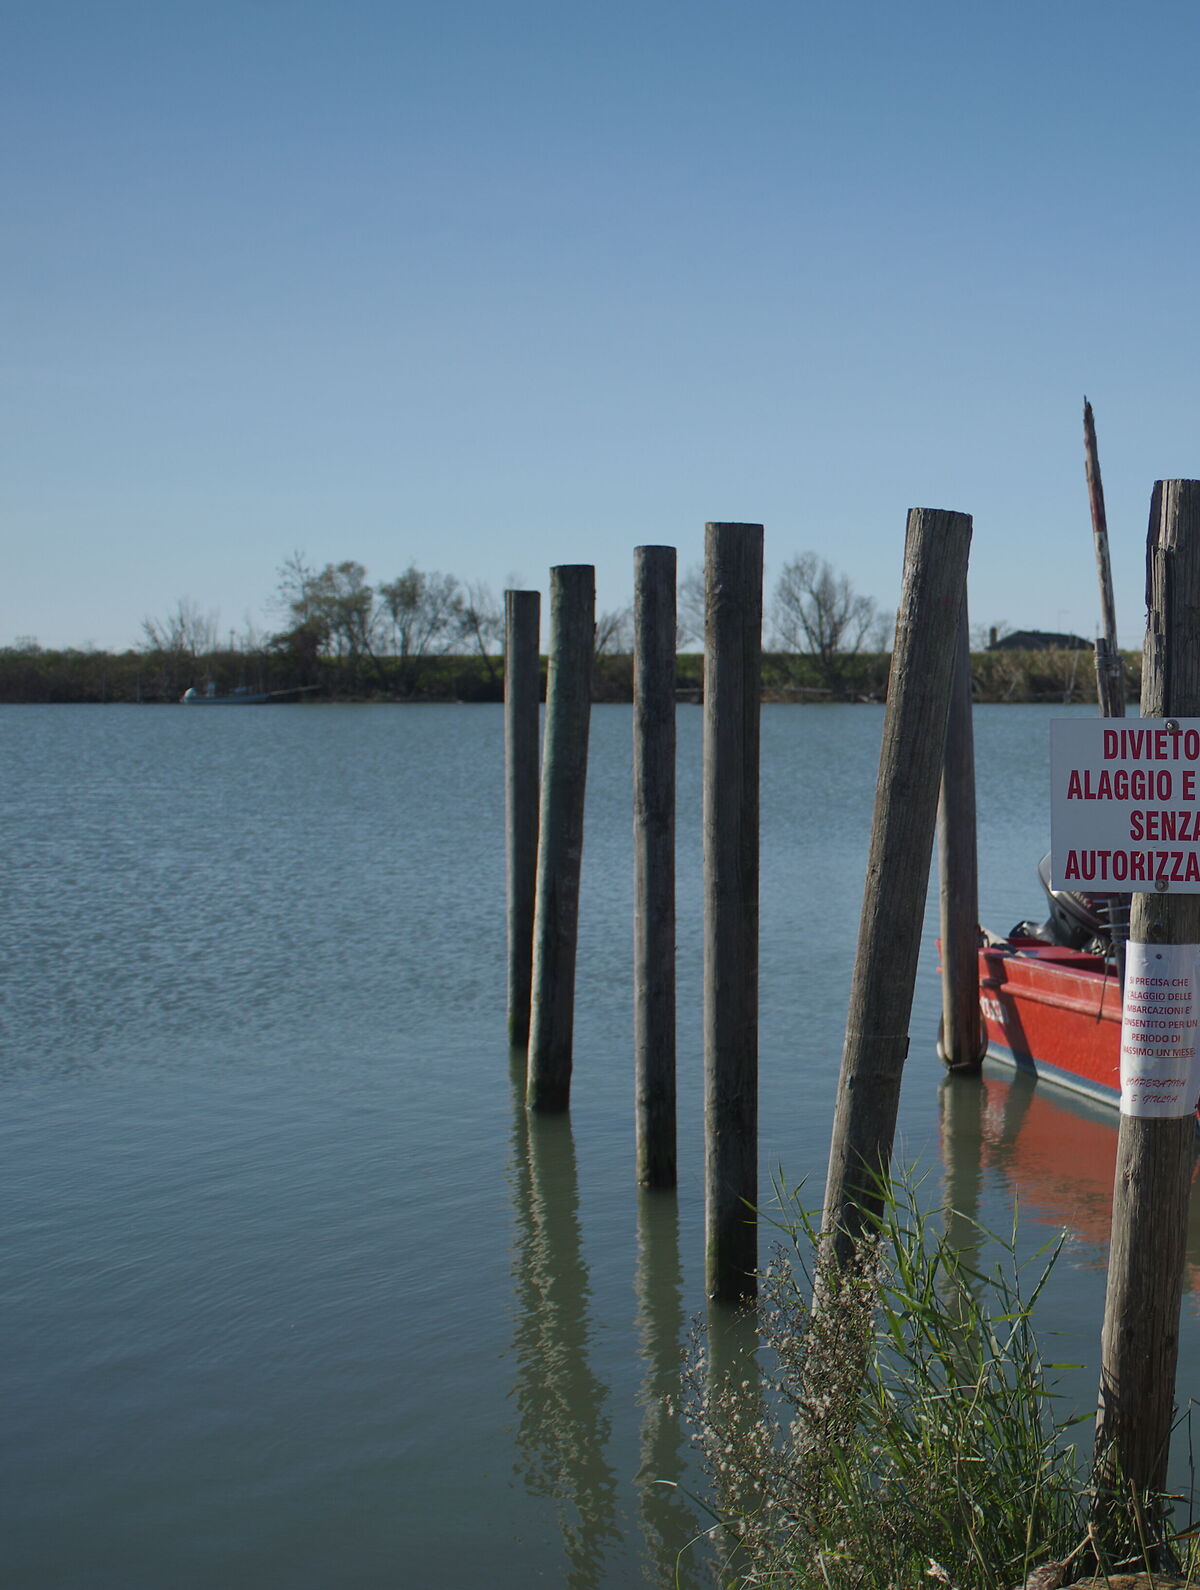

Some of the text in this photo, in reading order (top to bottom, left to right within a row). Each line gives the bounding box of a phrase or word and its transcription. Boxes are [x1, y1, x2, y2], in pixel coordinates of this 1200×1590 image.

[1104, 730, 1200, 760] DIVIETO
[1067, 770, 1172, 801] ALAGGIO
[1183, 770, 1196, 800] E
[1136, 977, 1169, 986] PRECISA
[1172, 978, 1188, 987] CHE
[1168, 992, 1192, 1001] DELLE
[1168, 1020, 1184, 1029] PER
[1186, 1019, 1198, 1028] UN
[1131, 1033, 1181, 1043] PERIODO DI
[1156, 1048, 1170, 1057] UN
